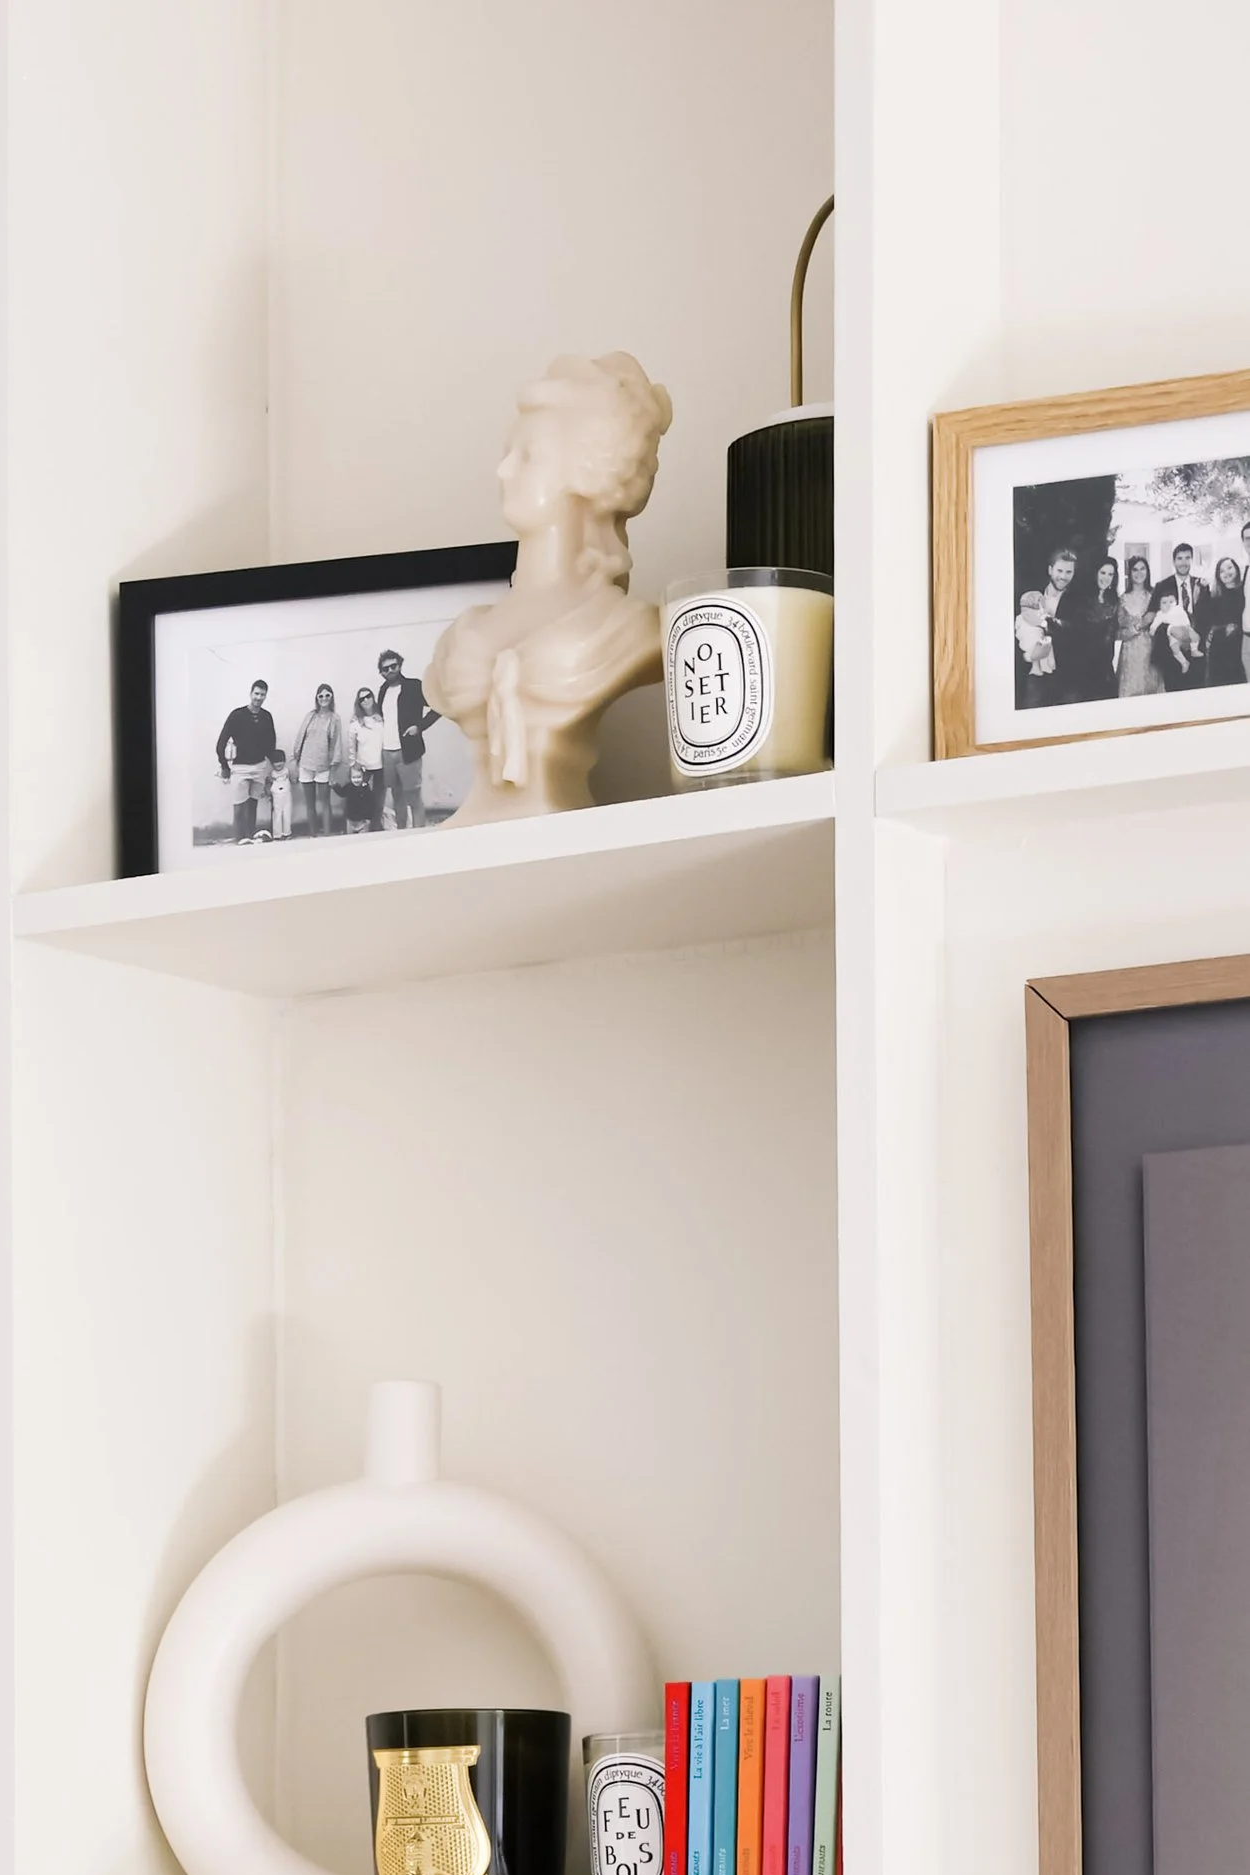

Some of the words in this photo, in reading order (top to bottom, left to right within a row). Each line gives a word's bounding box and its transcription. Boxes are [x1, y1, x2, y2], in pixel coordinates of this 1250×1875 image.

[682, 611, 724, 627] diptyque
[694, 1700, 704, 1721] libre
[721, 1696, 730, 1716] mer
[823, 1691, 833, 1717] route
[720, 1718, 729, 1730] La
[823, 1718, 832, 1731] La
[694, 1752, 703, 1765] vie
[694, 1767, 703, 1779] La
[615, 1831, 637, 1840] DE
